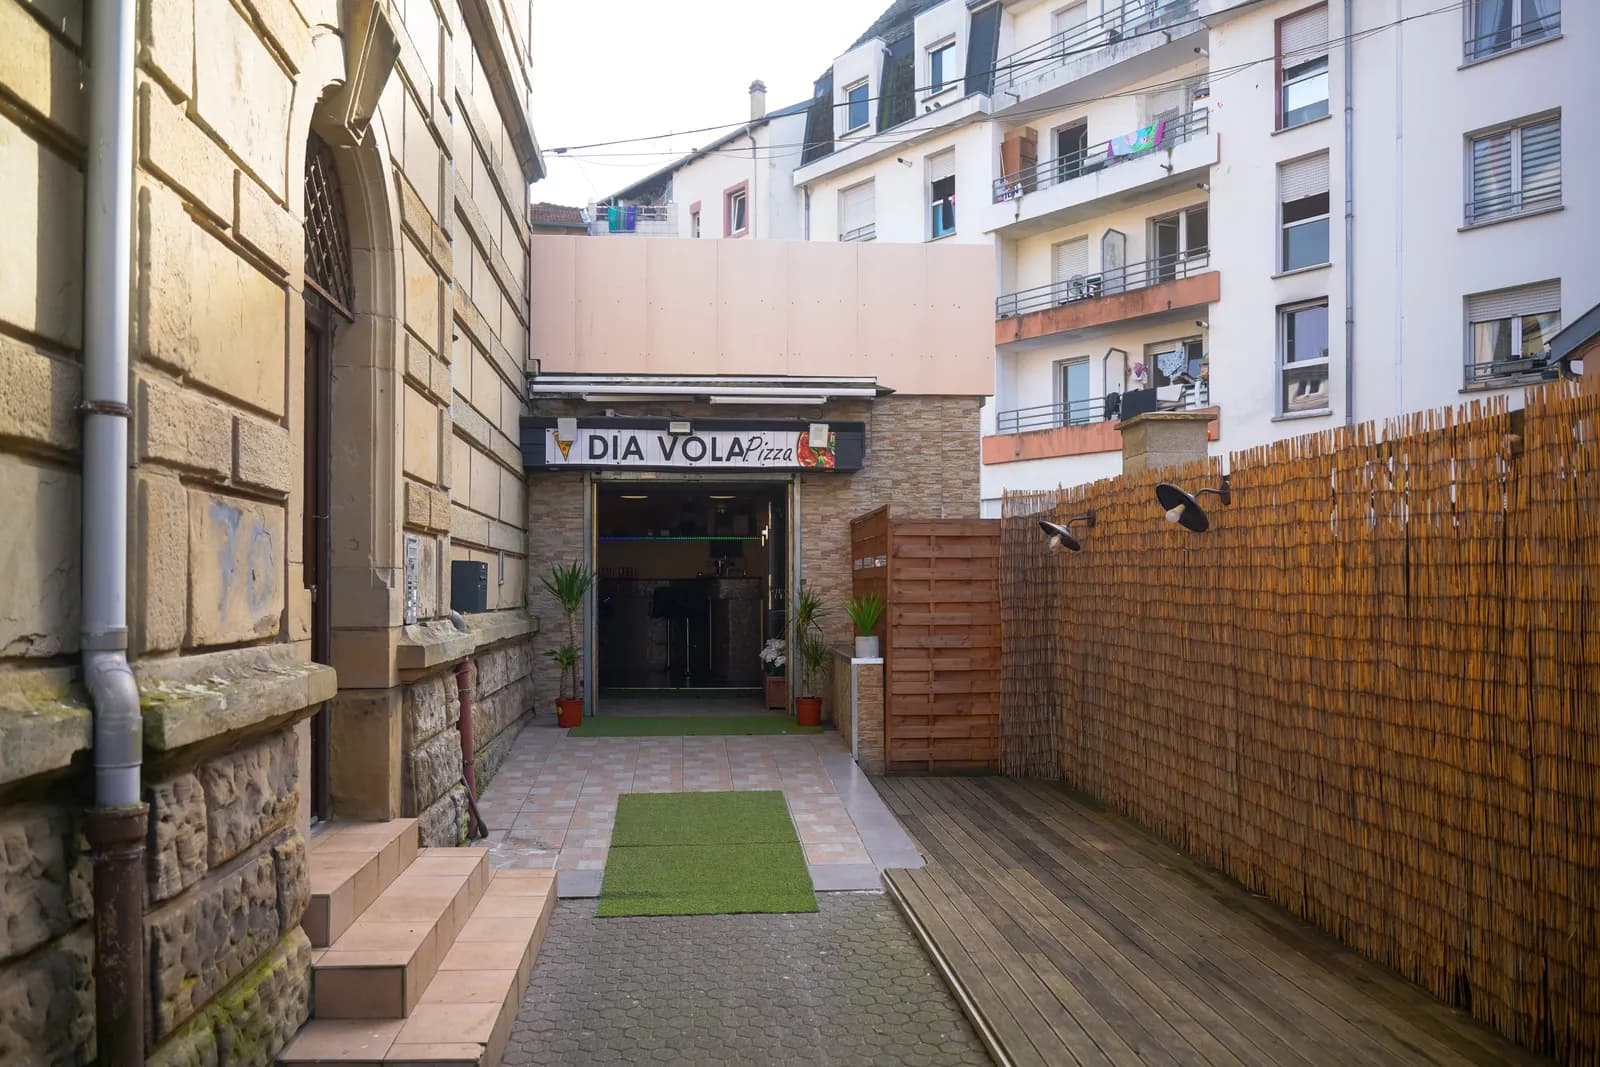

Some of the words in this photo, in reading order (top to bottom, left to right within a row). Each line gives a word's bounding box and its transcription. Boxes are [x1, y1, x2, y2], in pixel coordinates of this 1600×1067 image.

[589, 434, 645, 461] DIA
[657, 435, 744, 462] VOLA
[742, 436, 793, 462] Pizza
